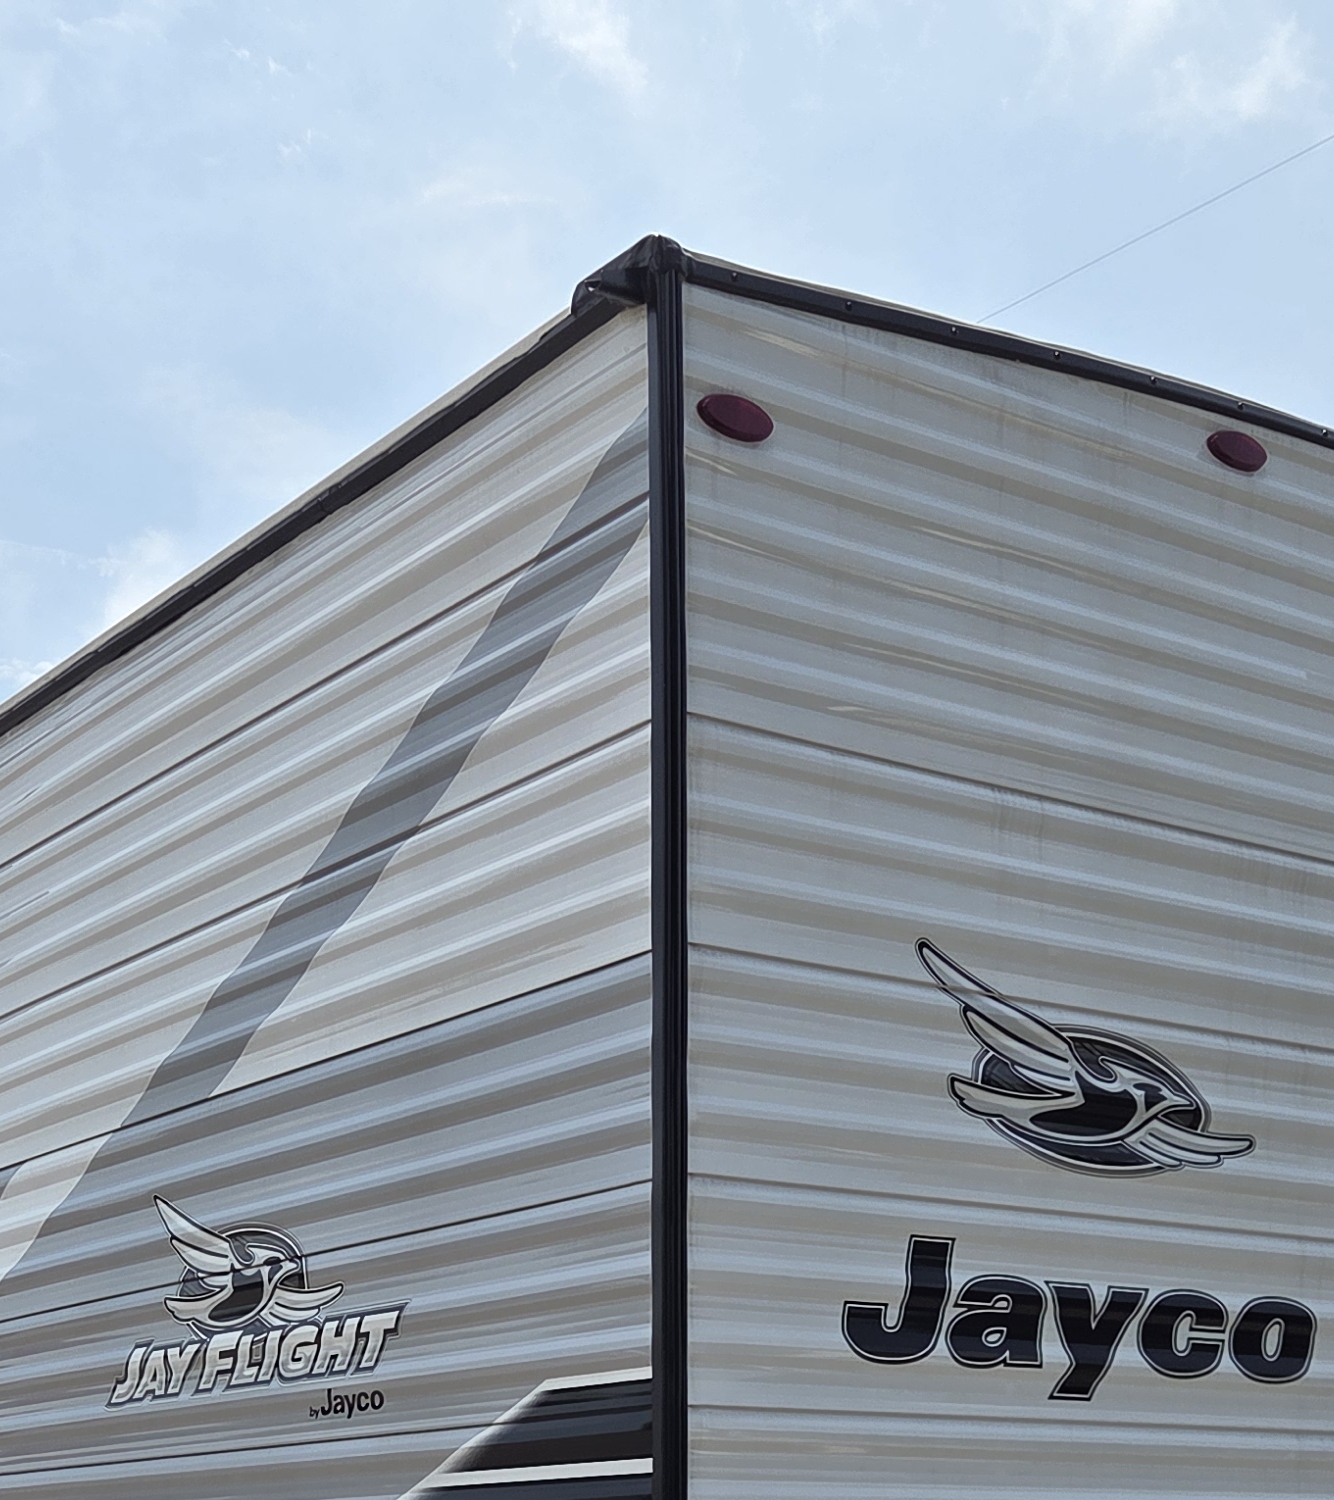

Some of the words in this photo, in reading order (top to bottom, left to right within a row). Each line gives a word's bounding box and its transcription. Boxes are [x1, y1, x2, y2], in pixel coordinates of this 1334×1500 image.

[841, 1234, 1318, 1402] Jayco
[309, 1405, 320, 1419] by
[320, 1388, 385, 1419] Jayco
